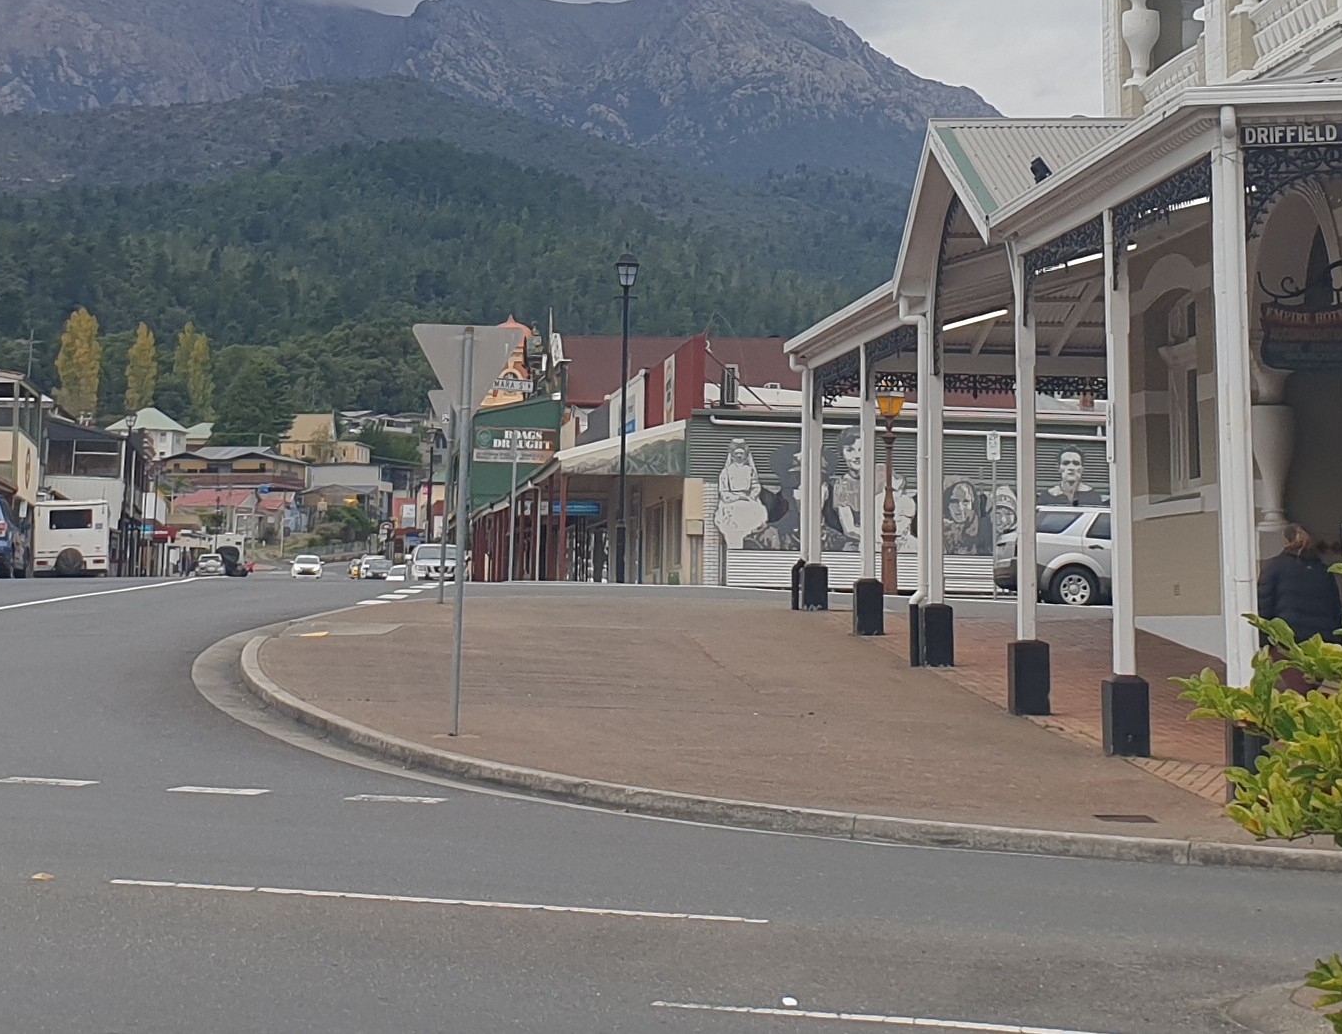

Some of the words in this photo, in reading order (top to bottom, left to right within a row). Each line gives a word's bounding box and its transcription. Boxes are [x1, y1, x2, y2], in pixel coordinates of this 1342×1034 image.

[1245, 124, 1337, 144] DRIFFIELD
[1265, 307, 1311, 323] EMPIRE
[493, 439, 552, 450] DRUGHT
